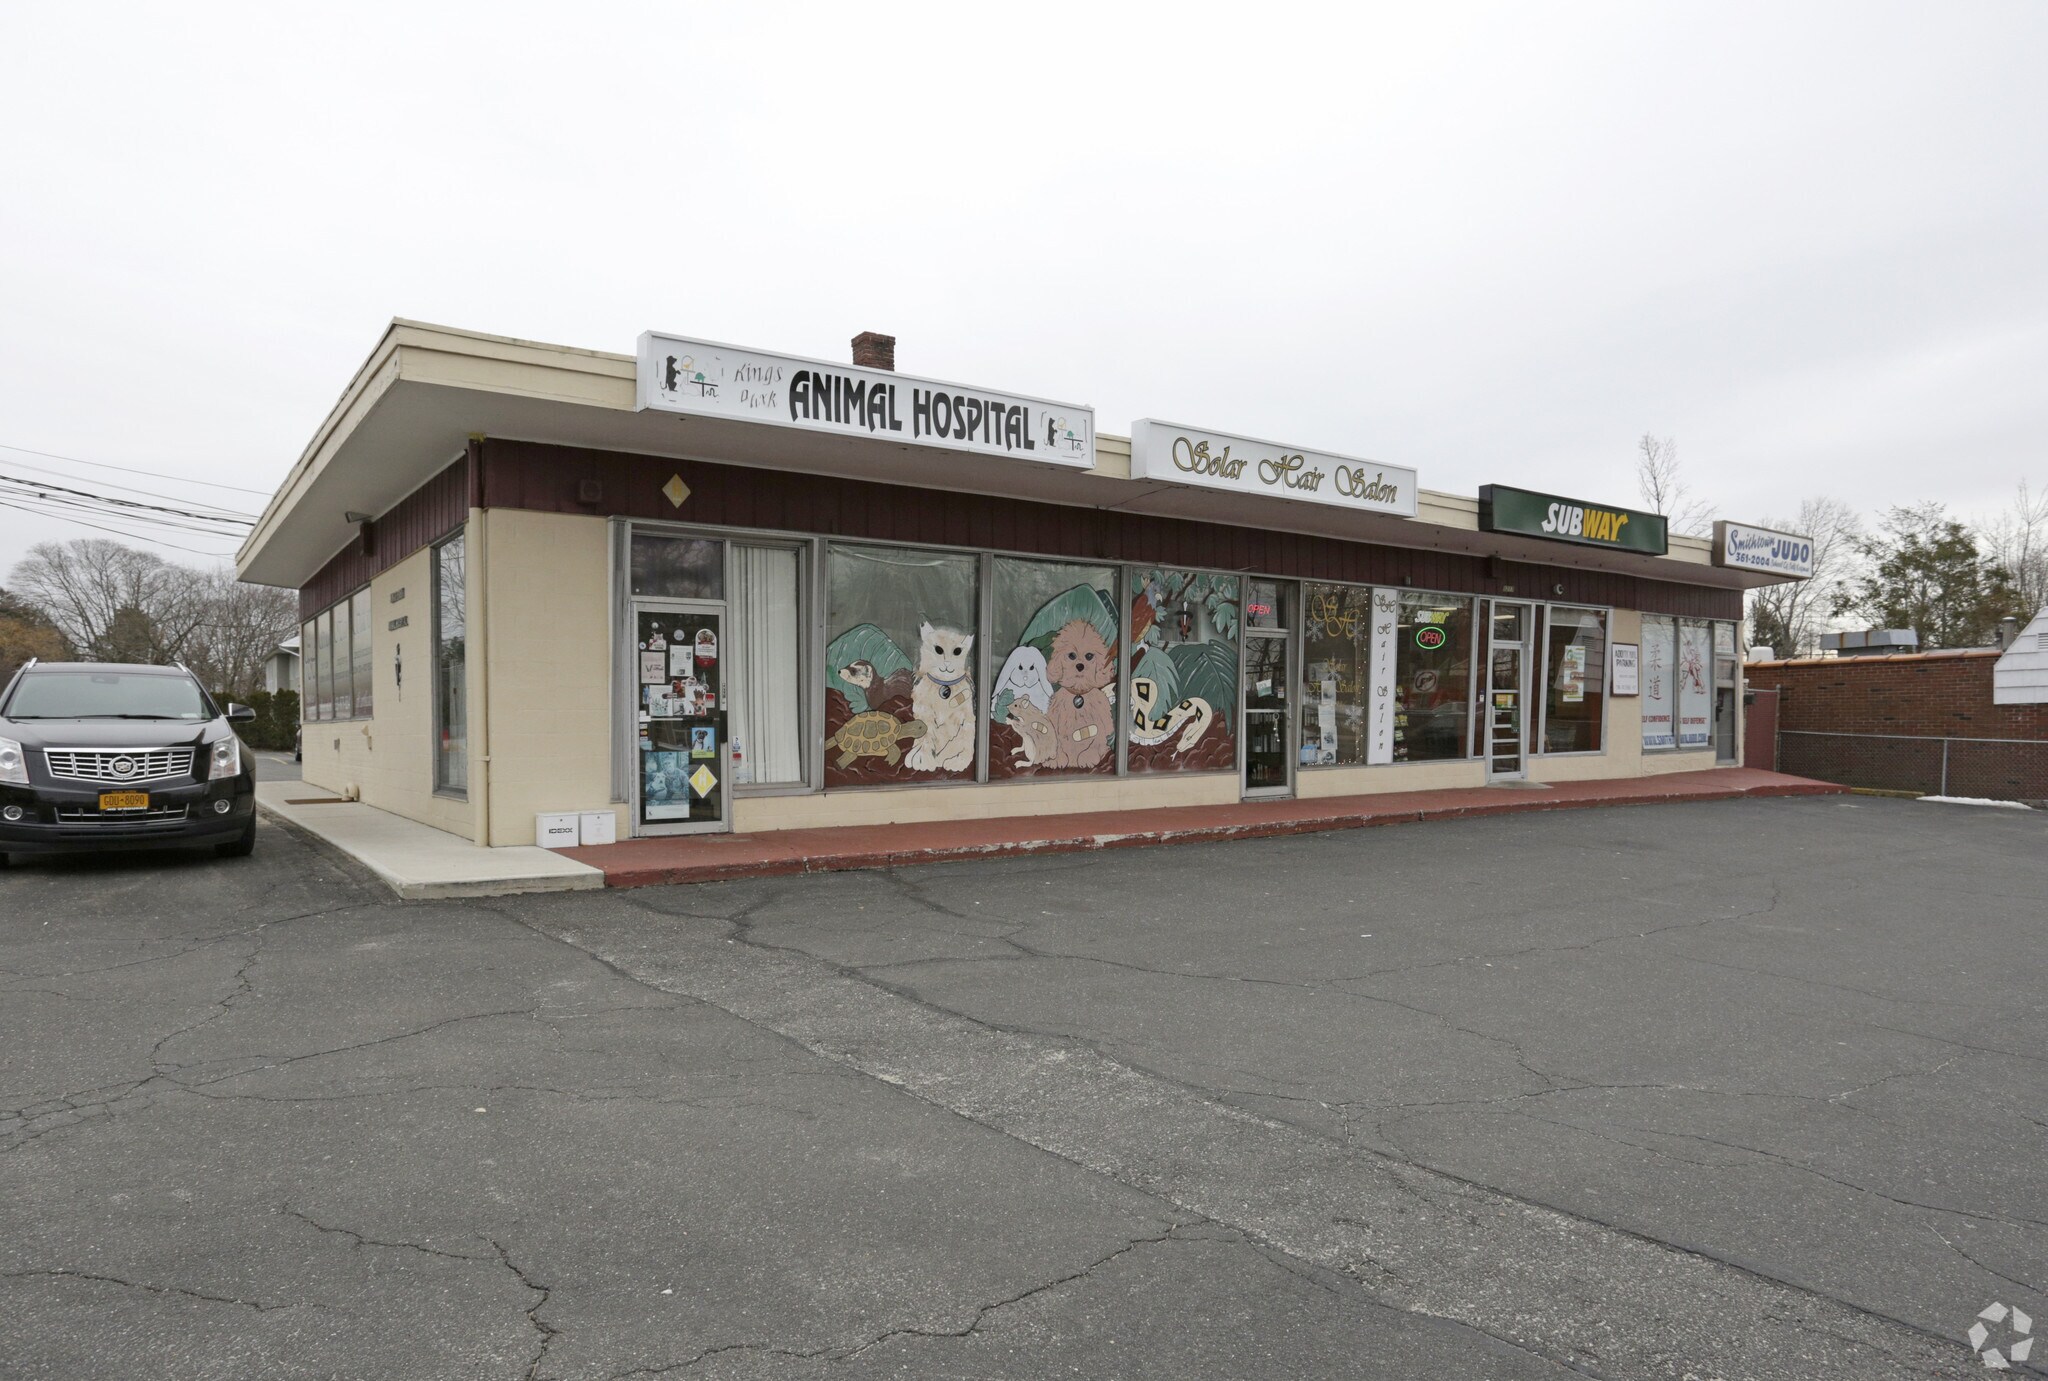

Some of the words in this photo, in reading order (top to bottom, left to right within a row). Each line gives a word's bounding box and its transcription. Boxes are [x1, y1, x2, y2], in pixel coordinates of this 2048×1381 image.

[734, 363, 783, 386] Kings
[789, 370, 903, 433] ANIMAL
[913, 388, 1035, 452] HOSPITAL
[1172, 436, 1248, 480] Solar
[1257, 454, 1325, 492] Hair
[1335, 464, 1398, 504] Salon
[1541, 502, 1628, 541] SUBWAY
[1728, 529, 1776, 556] Smithtown
[1771, 539, 1810, 564] JUDO
[1248, 604, 1271, 616] OPEN
[1414, 610, 1450, 624] SUBWAY
[1419, 631, 1442, 644] OPEN
